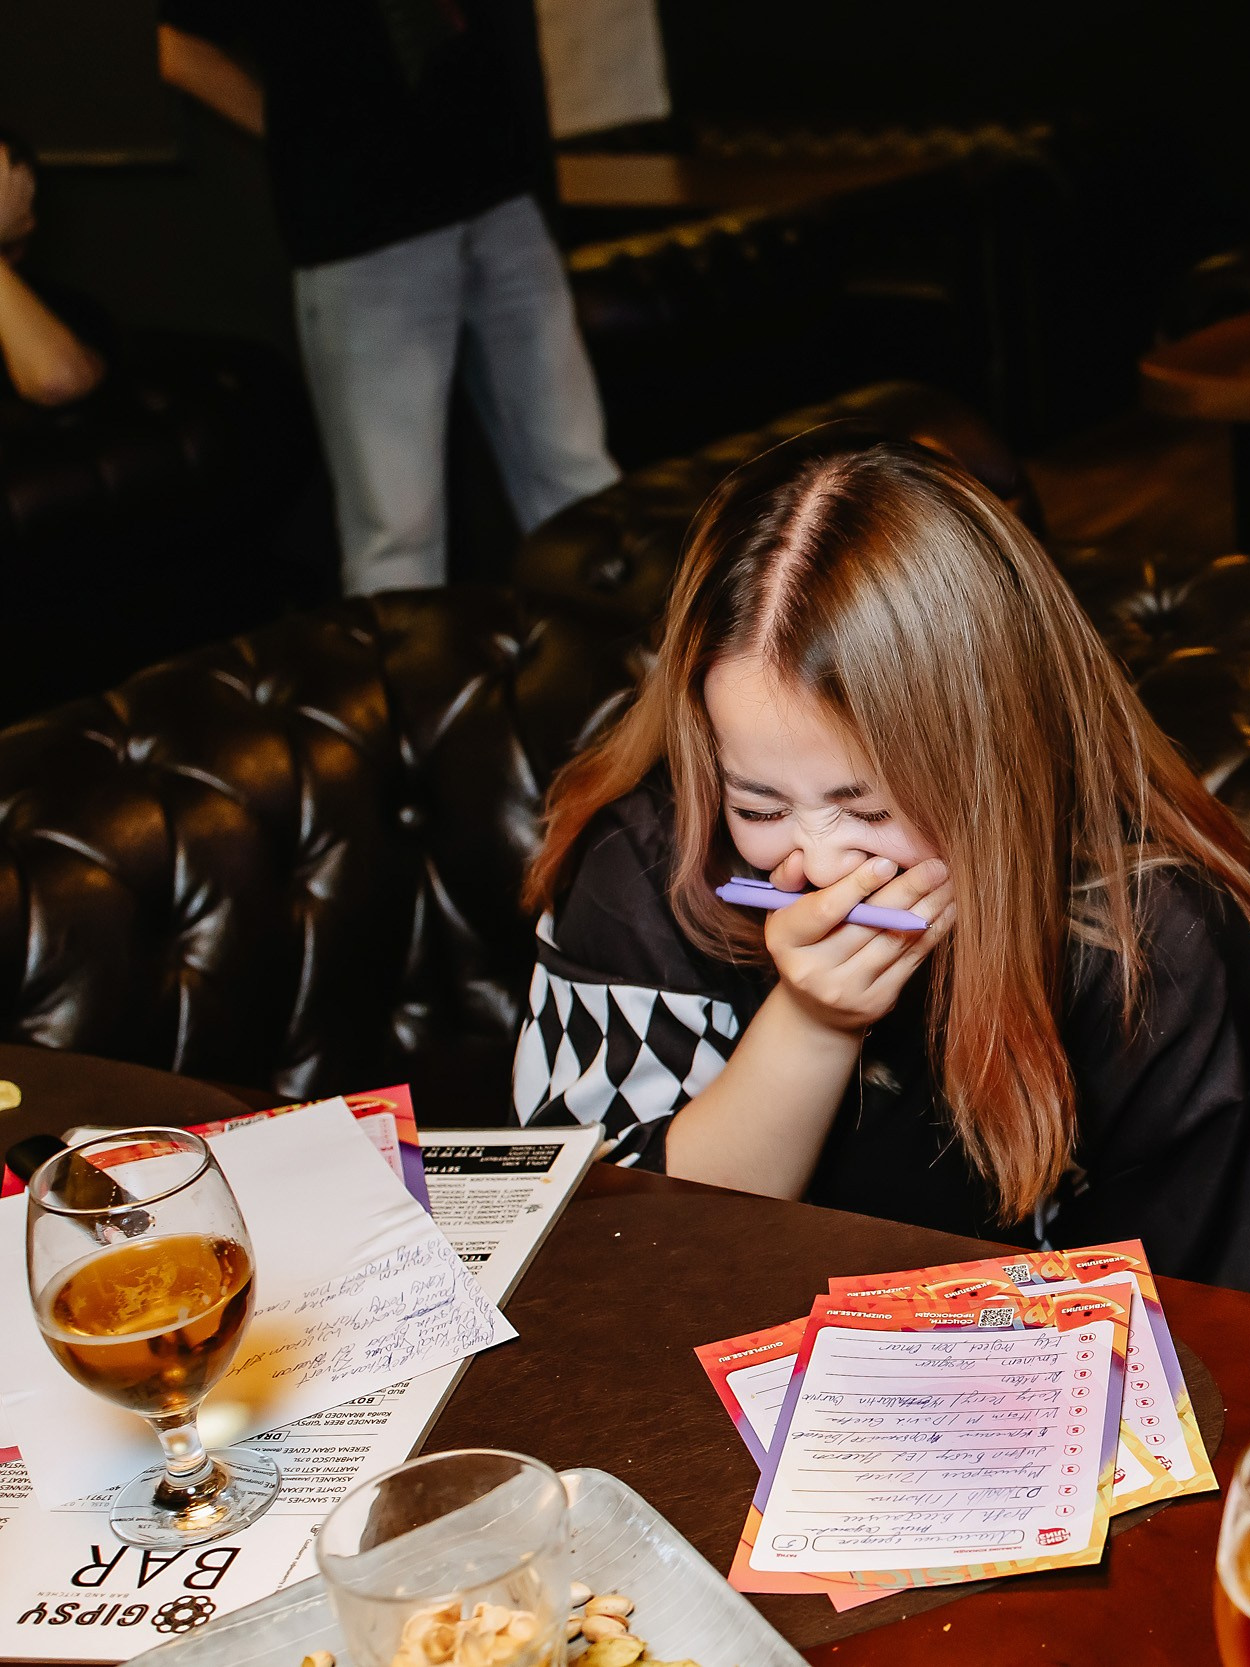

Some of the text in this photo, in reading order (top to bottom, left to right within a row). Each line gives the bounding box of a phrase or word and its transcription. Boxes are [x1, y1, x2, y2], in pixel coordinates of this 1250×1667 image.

[1060, 1301, 1112, 1314] #КВИЗПЛИЗ
[826, 1309, 893, 1320] QUIZPLEASE.RU
[914, 1311, 976, 1320] ПРОМОКОДЫ
[718, 1340, 784, 1363] QUIZPLEASE.RU
[343, 1397, 375, 1405] BOT
[1074, 1407, 1083, 1415] 6
[245, 1432, 283, 1441] DRA
[287, 1496, 327, 1504] SANCHES
[328, 1496, 342, 1504] EL
[70, 1544, 242, 1590] BAR
[16, 1602, 150, 1627] GIPSY
